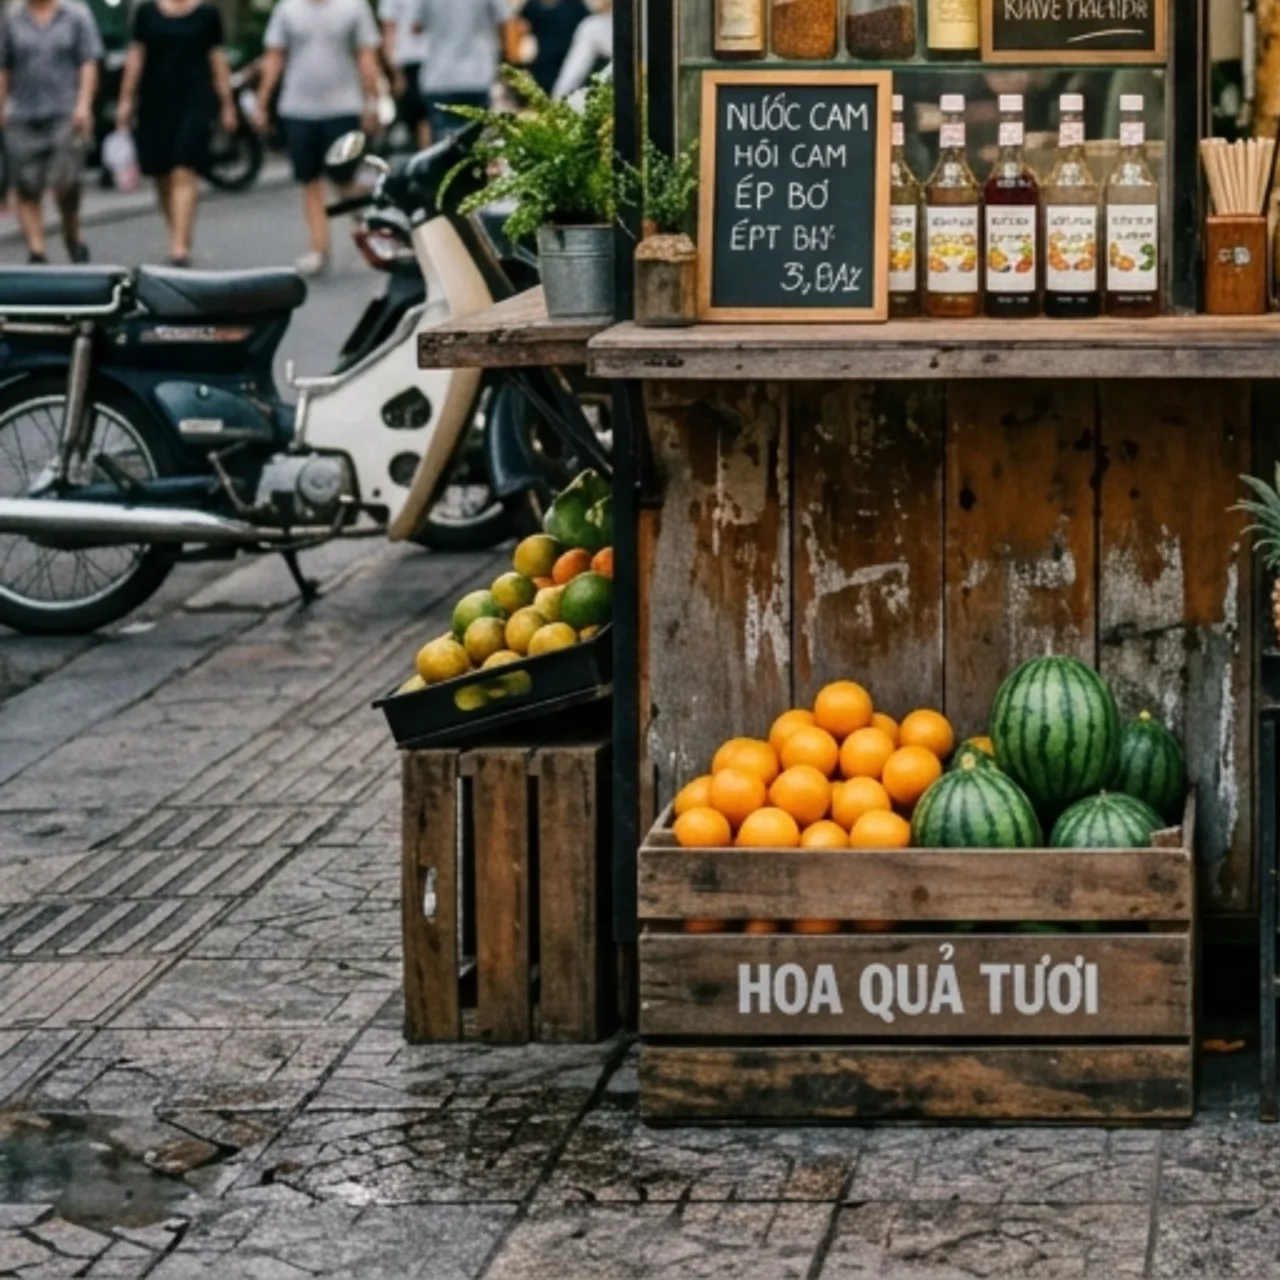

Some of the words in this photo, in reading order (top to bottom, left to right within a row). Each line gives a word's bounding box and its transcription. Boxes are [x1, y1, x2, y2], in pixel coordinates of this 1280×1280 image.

[809, 102, 869, 132] CAM
[790, 144, 847, 168] CAM
[734, 174, 774, 210] ÉP
[738, 963, 844, 1015] HOA
[858, 942, 965, 1023] QUẢ
[979, 954, 1099, 1015] TƯƠI
